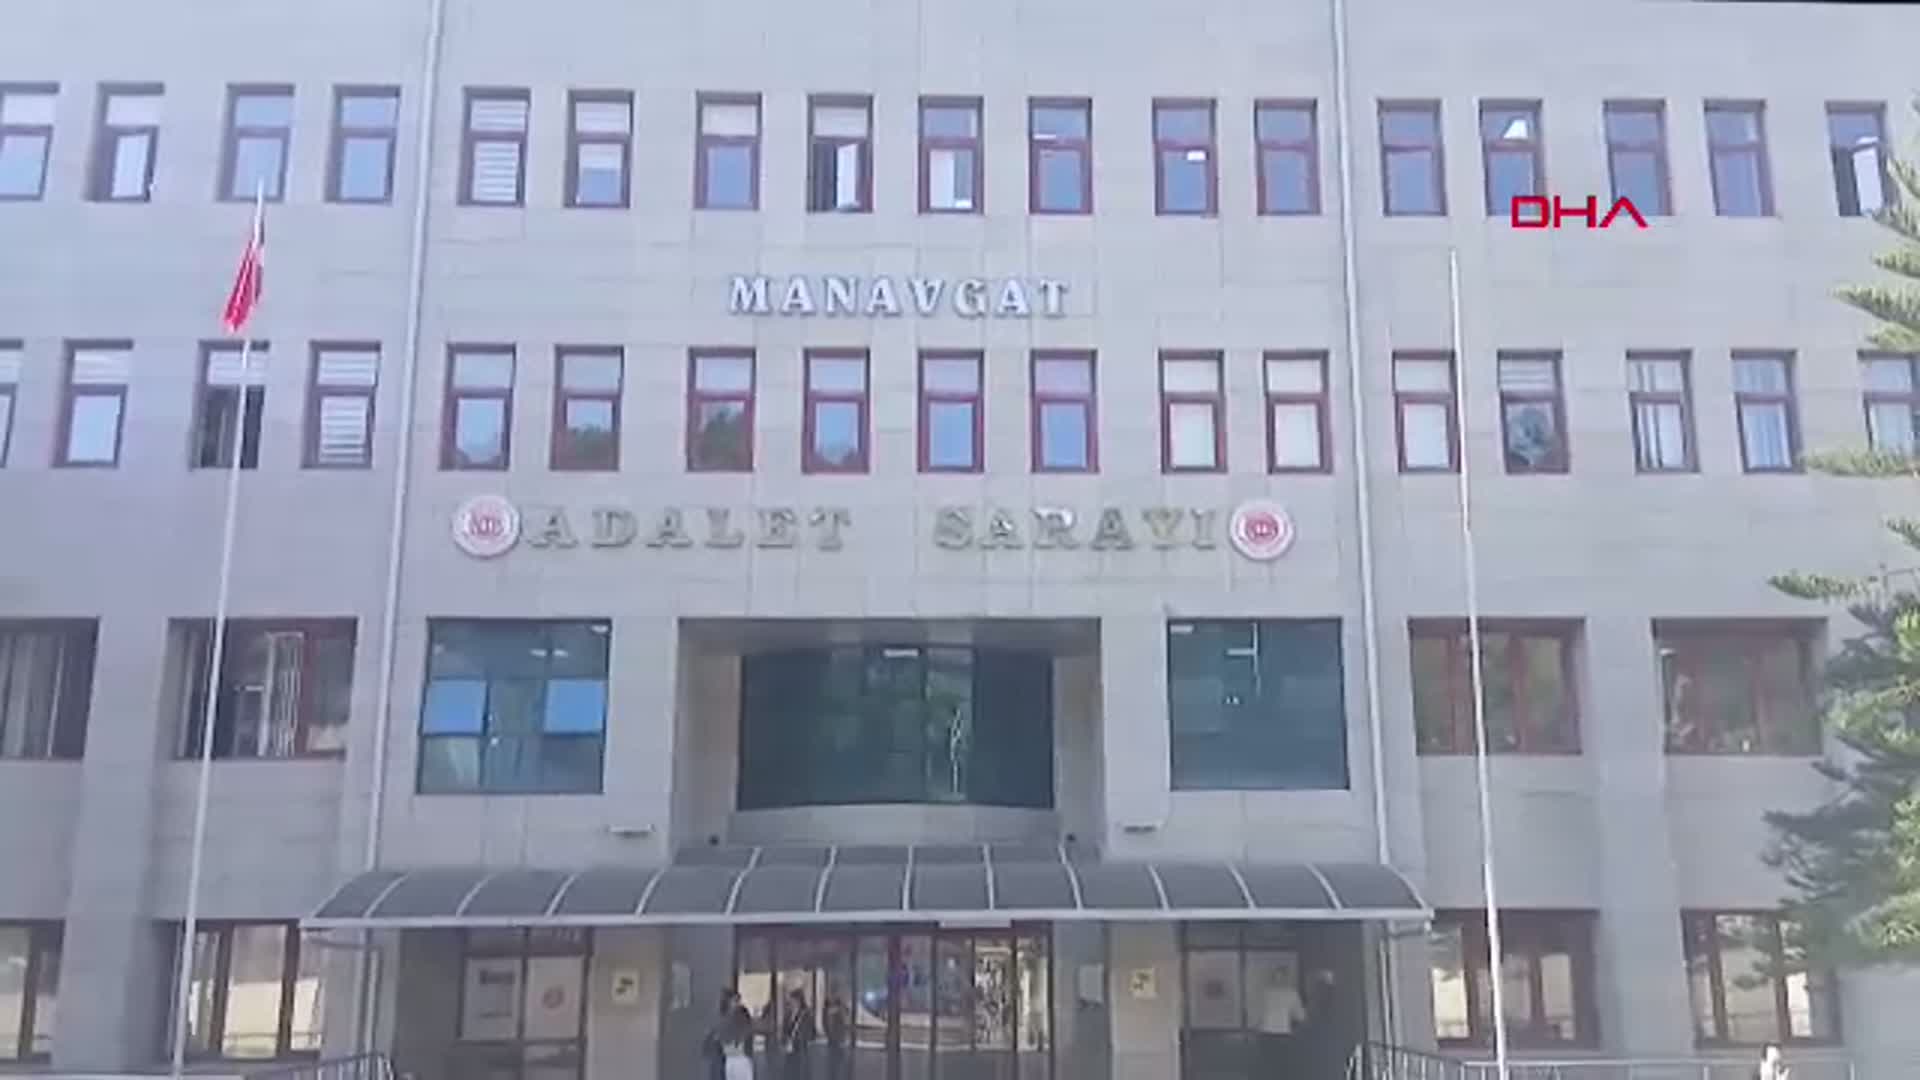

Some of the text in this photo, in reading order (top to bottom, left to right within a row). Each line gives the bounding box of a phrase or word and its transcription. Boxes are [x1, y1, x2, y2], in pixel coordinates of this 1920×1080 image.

[728, 275, 1071, 318] MANAVGAT
[526, 505, 1217, 550] ADALET SARAYI
